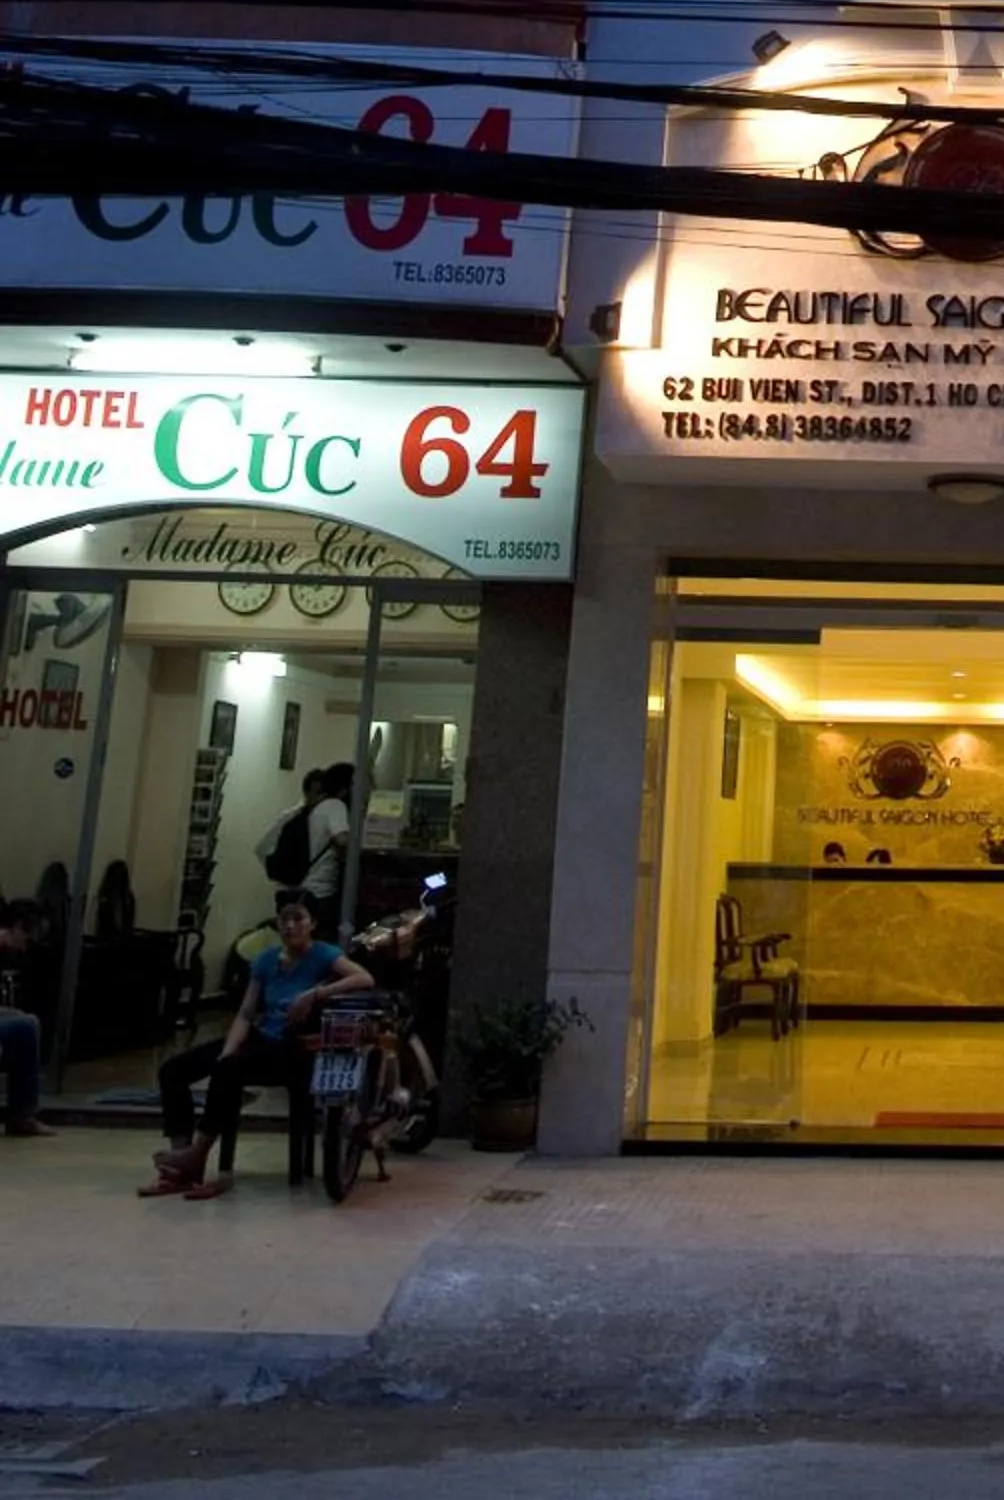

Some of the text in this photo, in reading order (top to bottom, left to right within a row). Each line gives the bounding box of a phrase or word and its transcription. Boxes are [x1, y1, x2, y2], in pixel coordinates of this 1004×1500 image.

[344, 95, 522, 256] 64
[393, 261, 506, 285] TEL:8365073
[715, 288, 912, 326] BEAUTIFUL
[711, 332, 840, 360] KHÁCH
[852, 340, 930, 368] SẠN
[25, 387, 144, 429] HOTEL
[662, 377, 694, 402] 62
[702, 378, 743, 402] BUI
[750, 379, 802, 402] VIEN
[949, 383, 979, 406] HO
[154, 393, 361, 496] Cúc
[400, 406, 549, 498] 64
[662, 411, 714, 439] TEL:
[795, 415, 912, 441] 38364852
[121, 516, 387, 568] Madame Cúc
[0, 688, 88, 731] HOTEL
